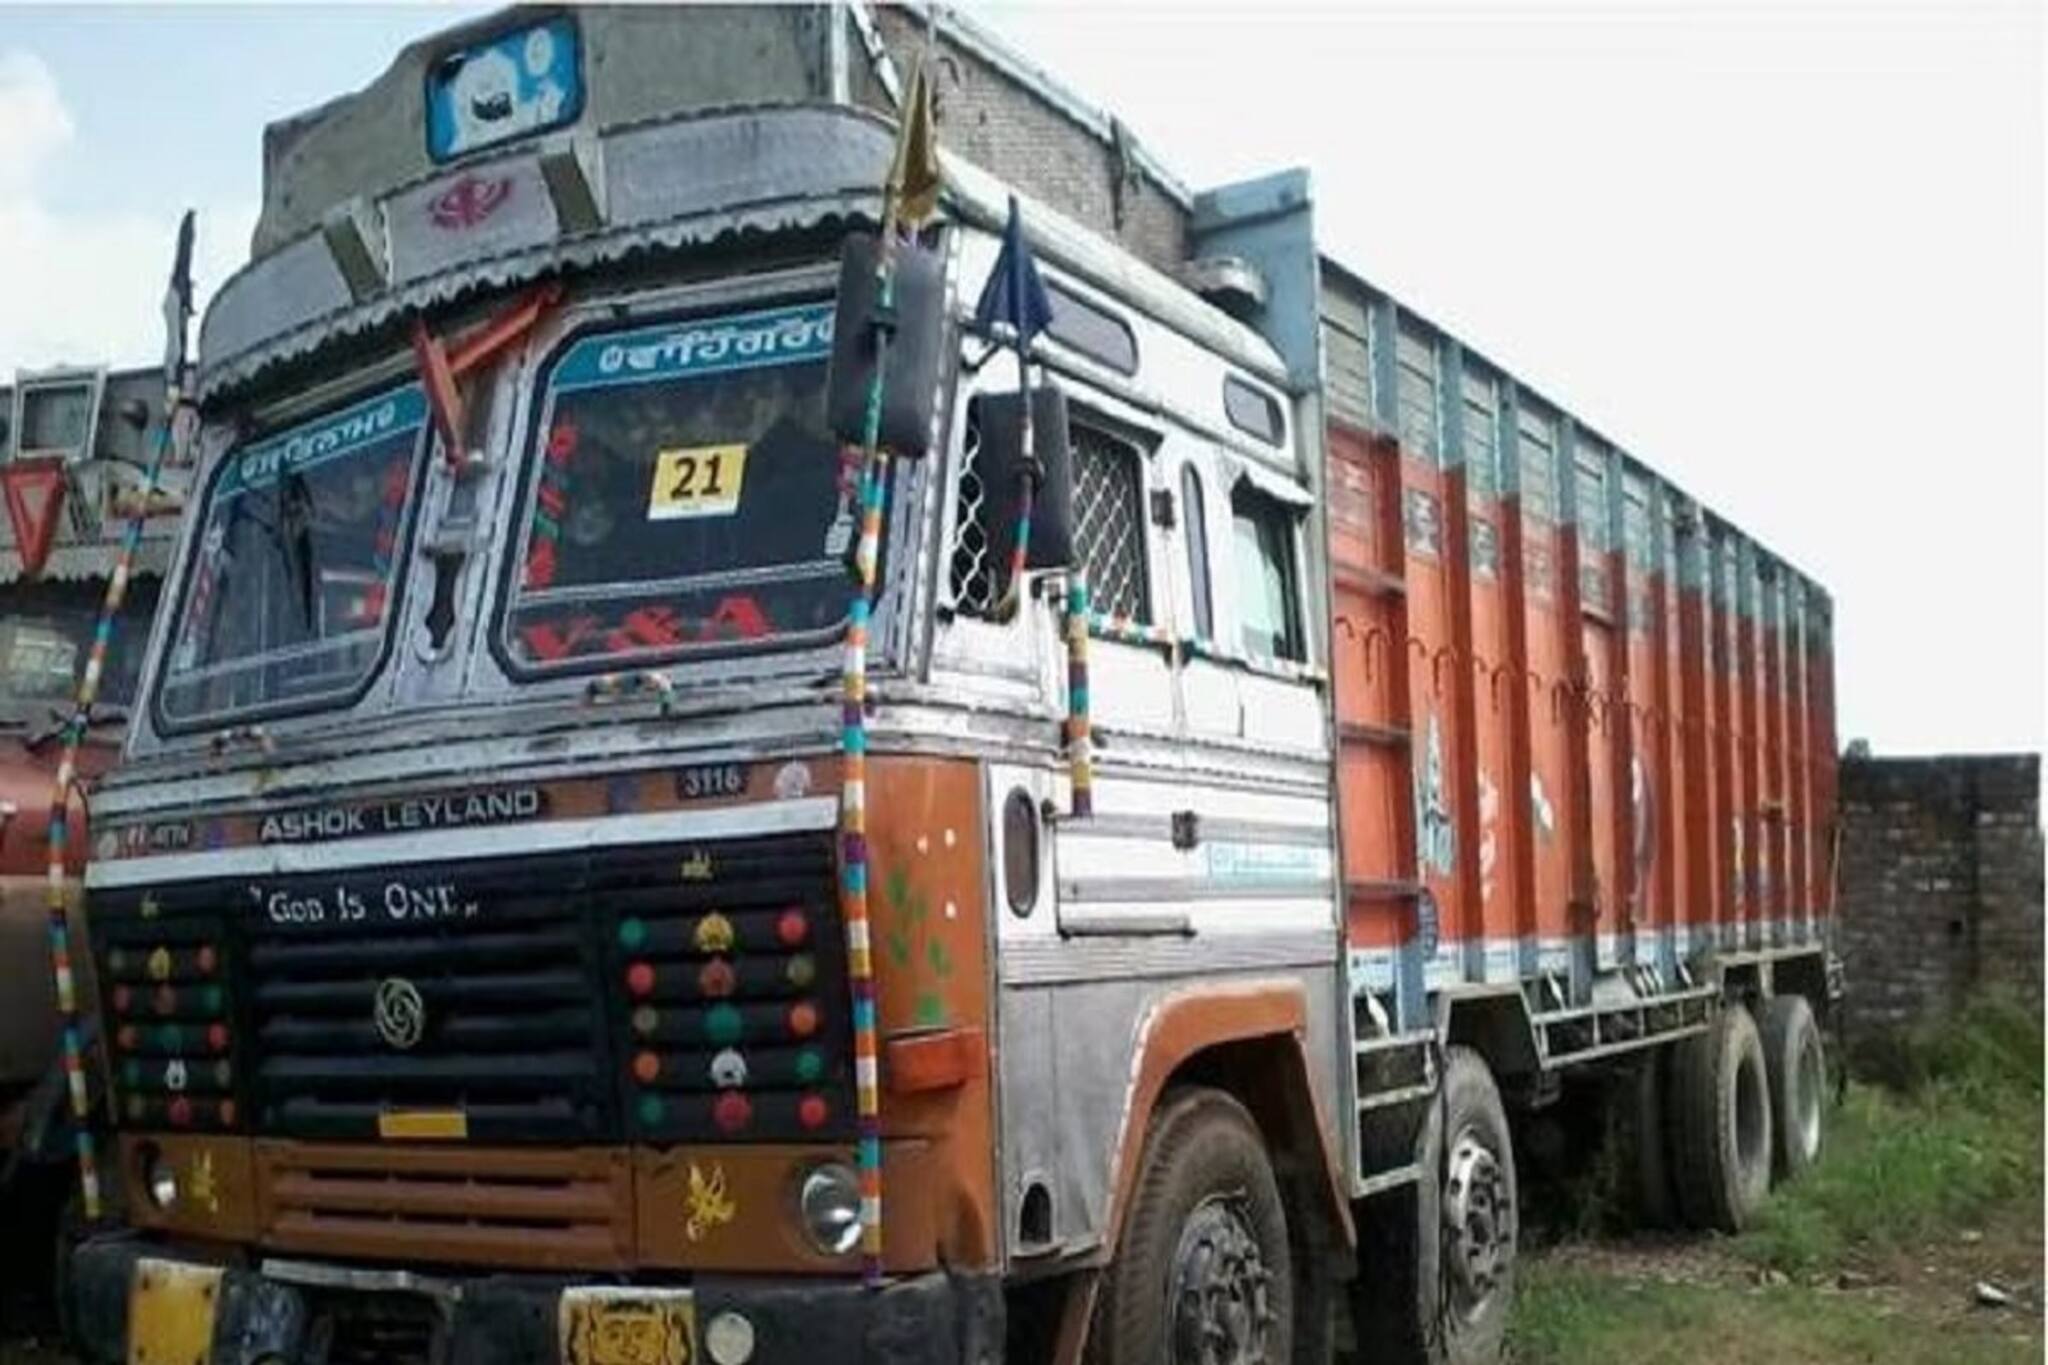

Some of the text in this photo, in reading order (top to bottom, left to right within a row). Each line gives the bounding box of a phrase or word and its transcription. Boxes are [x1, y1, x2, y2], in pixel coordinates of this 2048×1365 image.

[671, 454, 721, 499] 21
[260, 789, 540, 842] ASHOK LEYLAND
